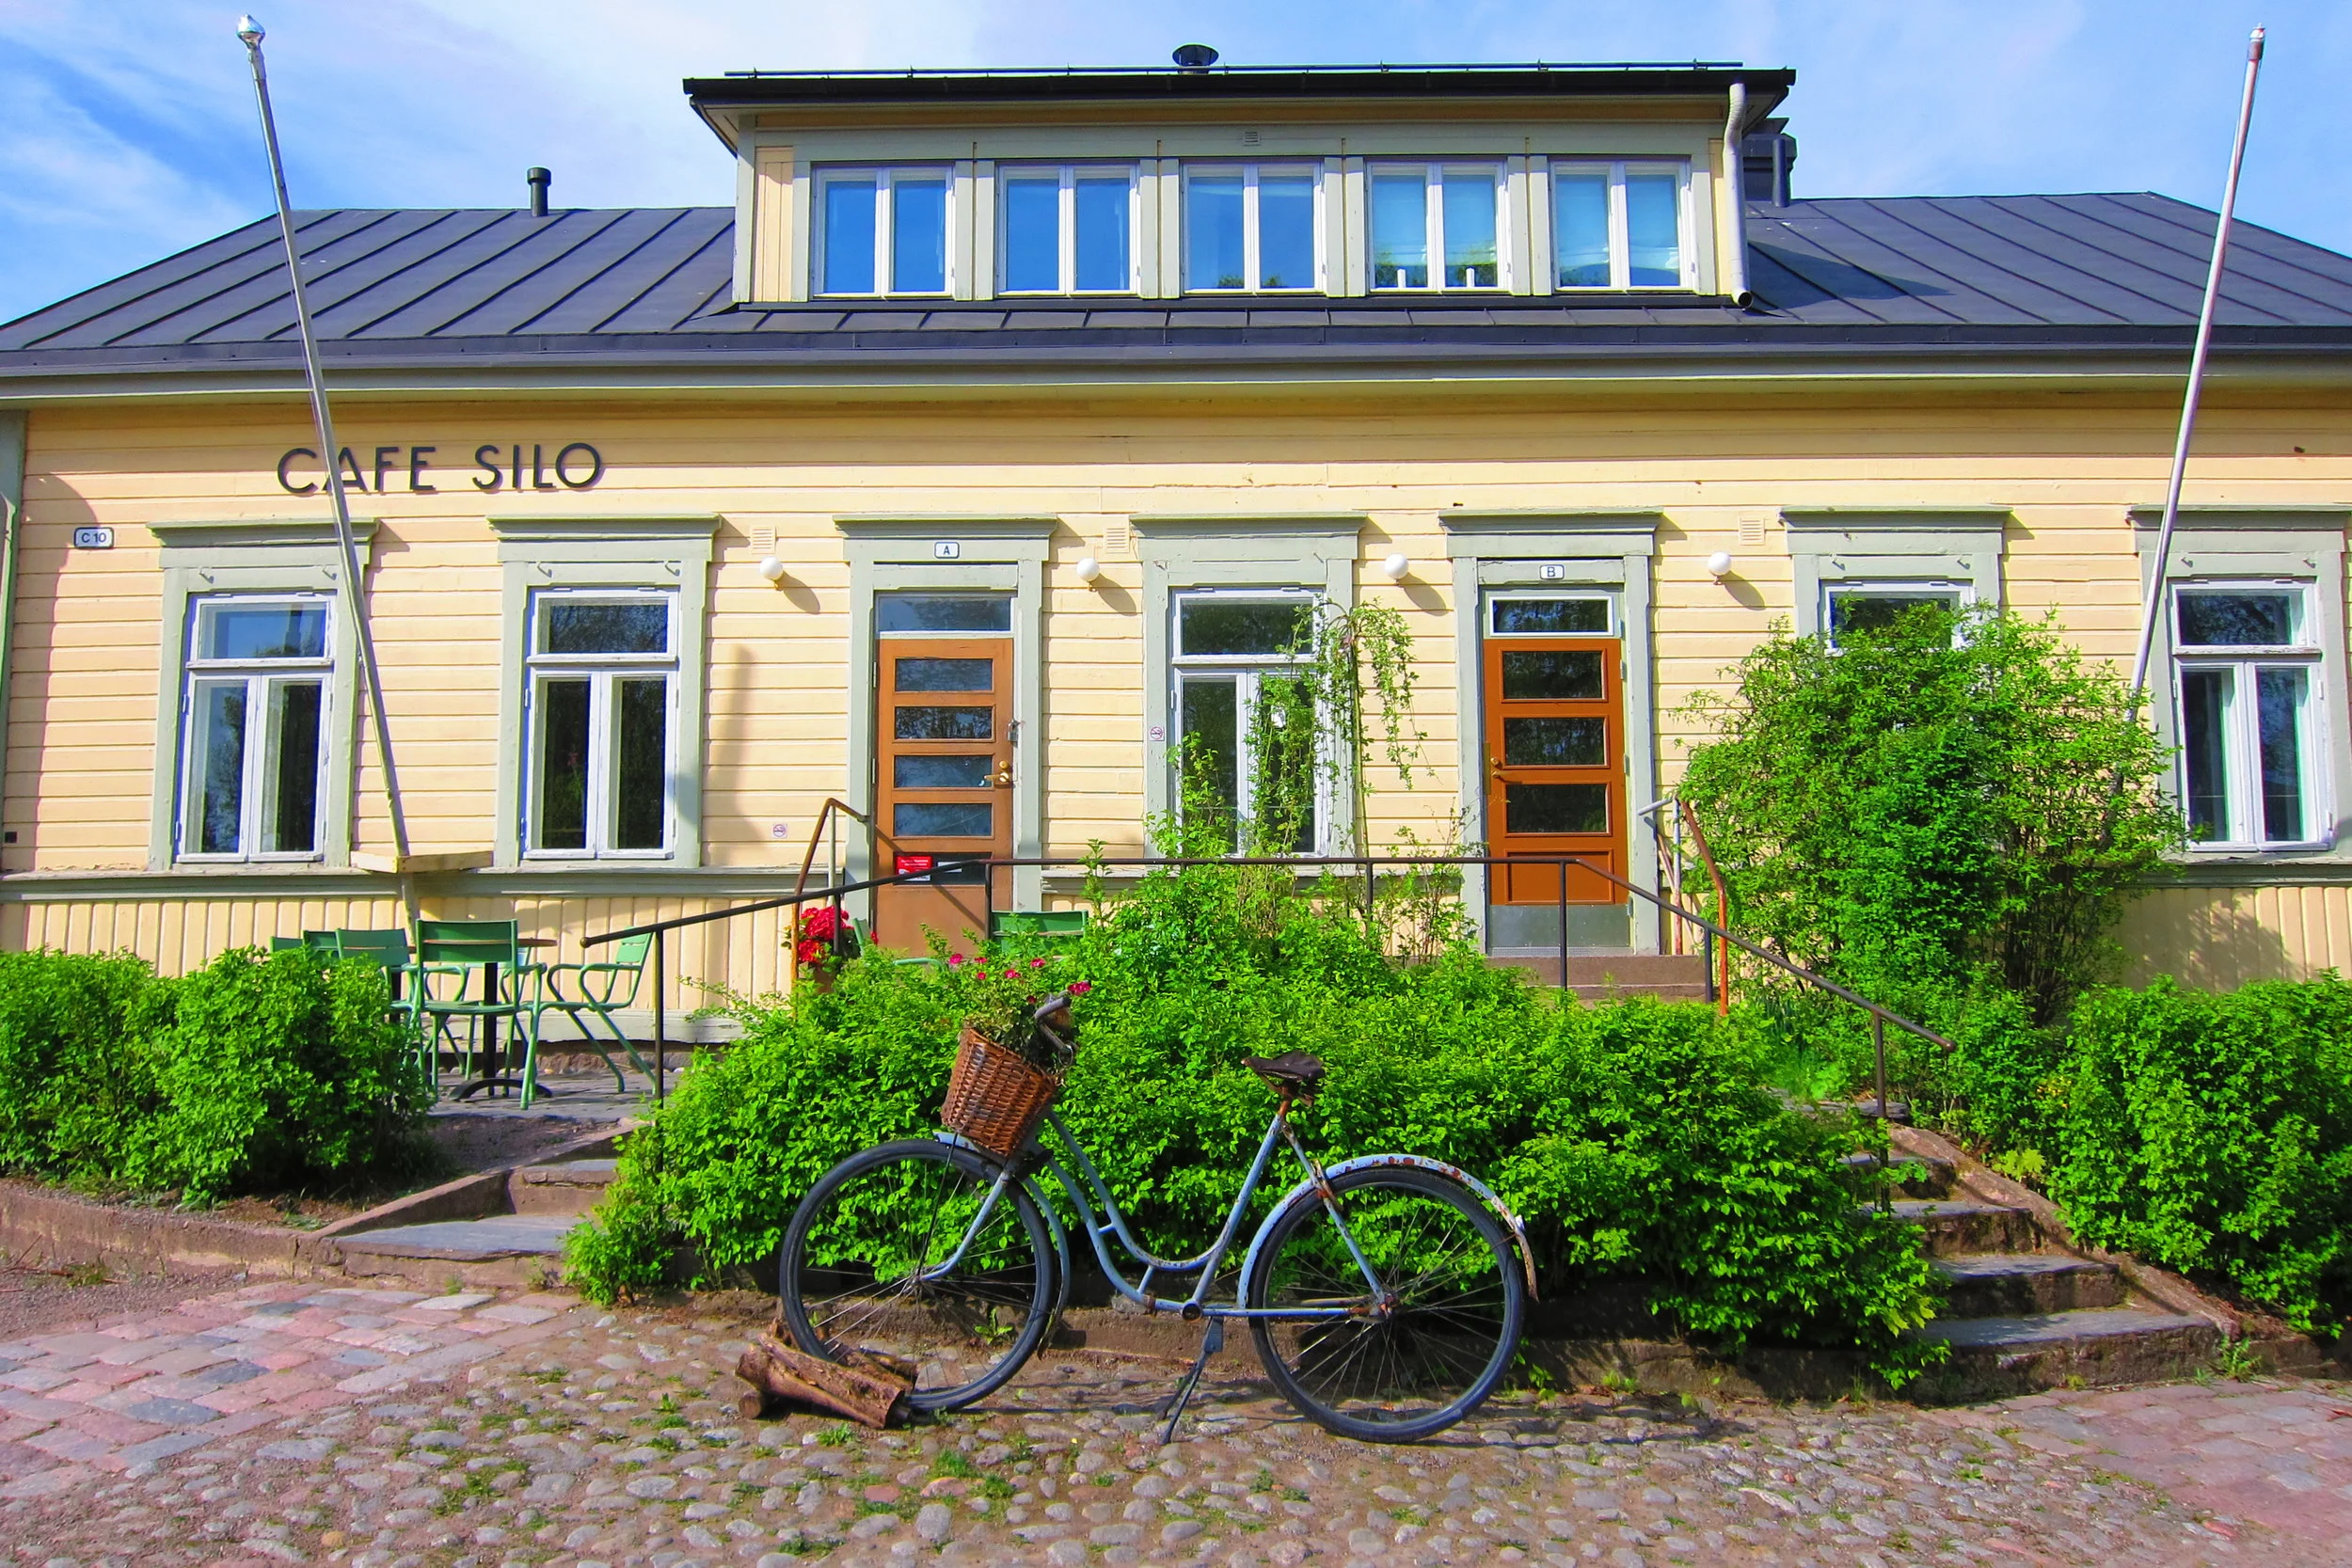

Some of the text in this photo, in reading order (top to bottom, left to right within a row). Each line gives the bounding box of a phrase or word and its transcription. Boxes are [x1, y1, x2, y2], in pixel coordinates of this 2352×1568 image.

[278, 442, 603, 493] CAFE SILO
[81, 532, 107, 544] C 10
[943, 545, 951, 556] A
[1547, 566, 1556, 578] B
